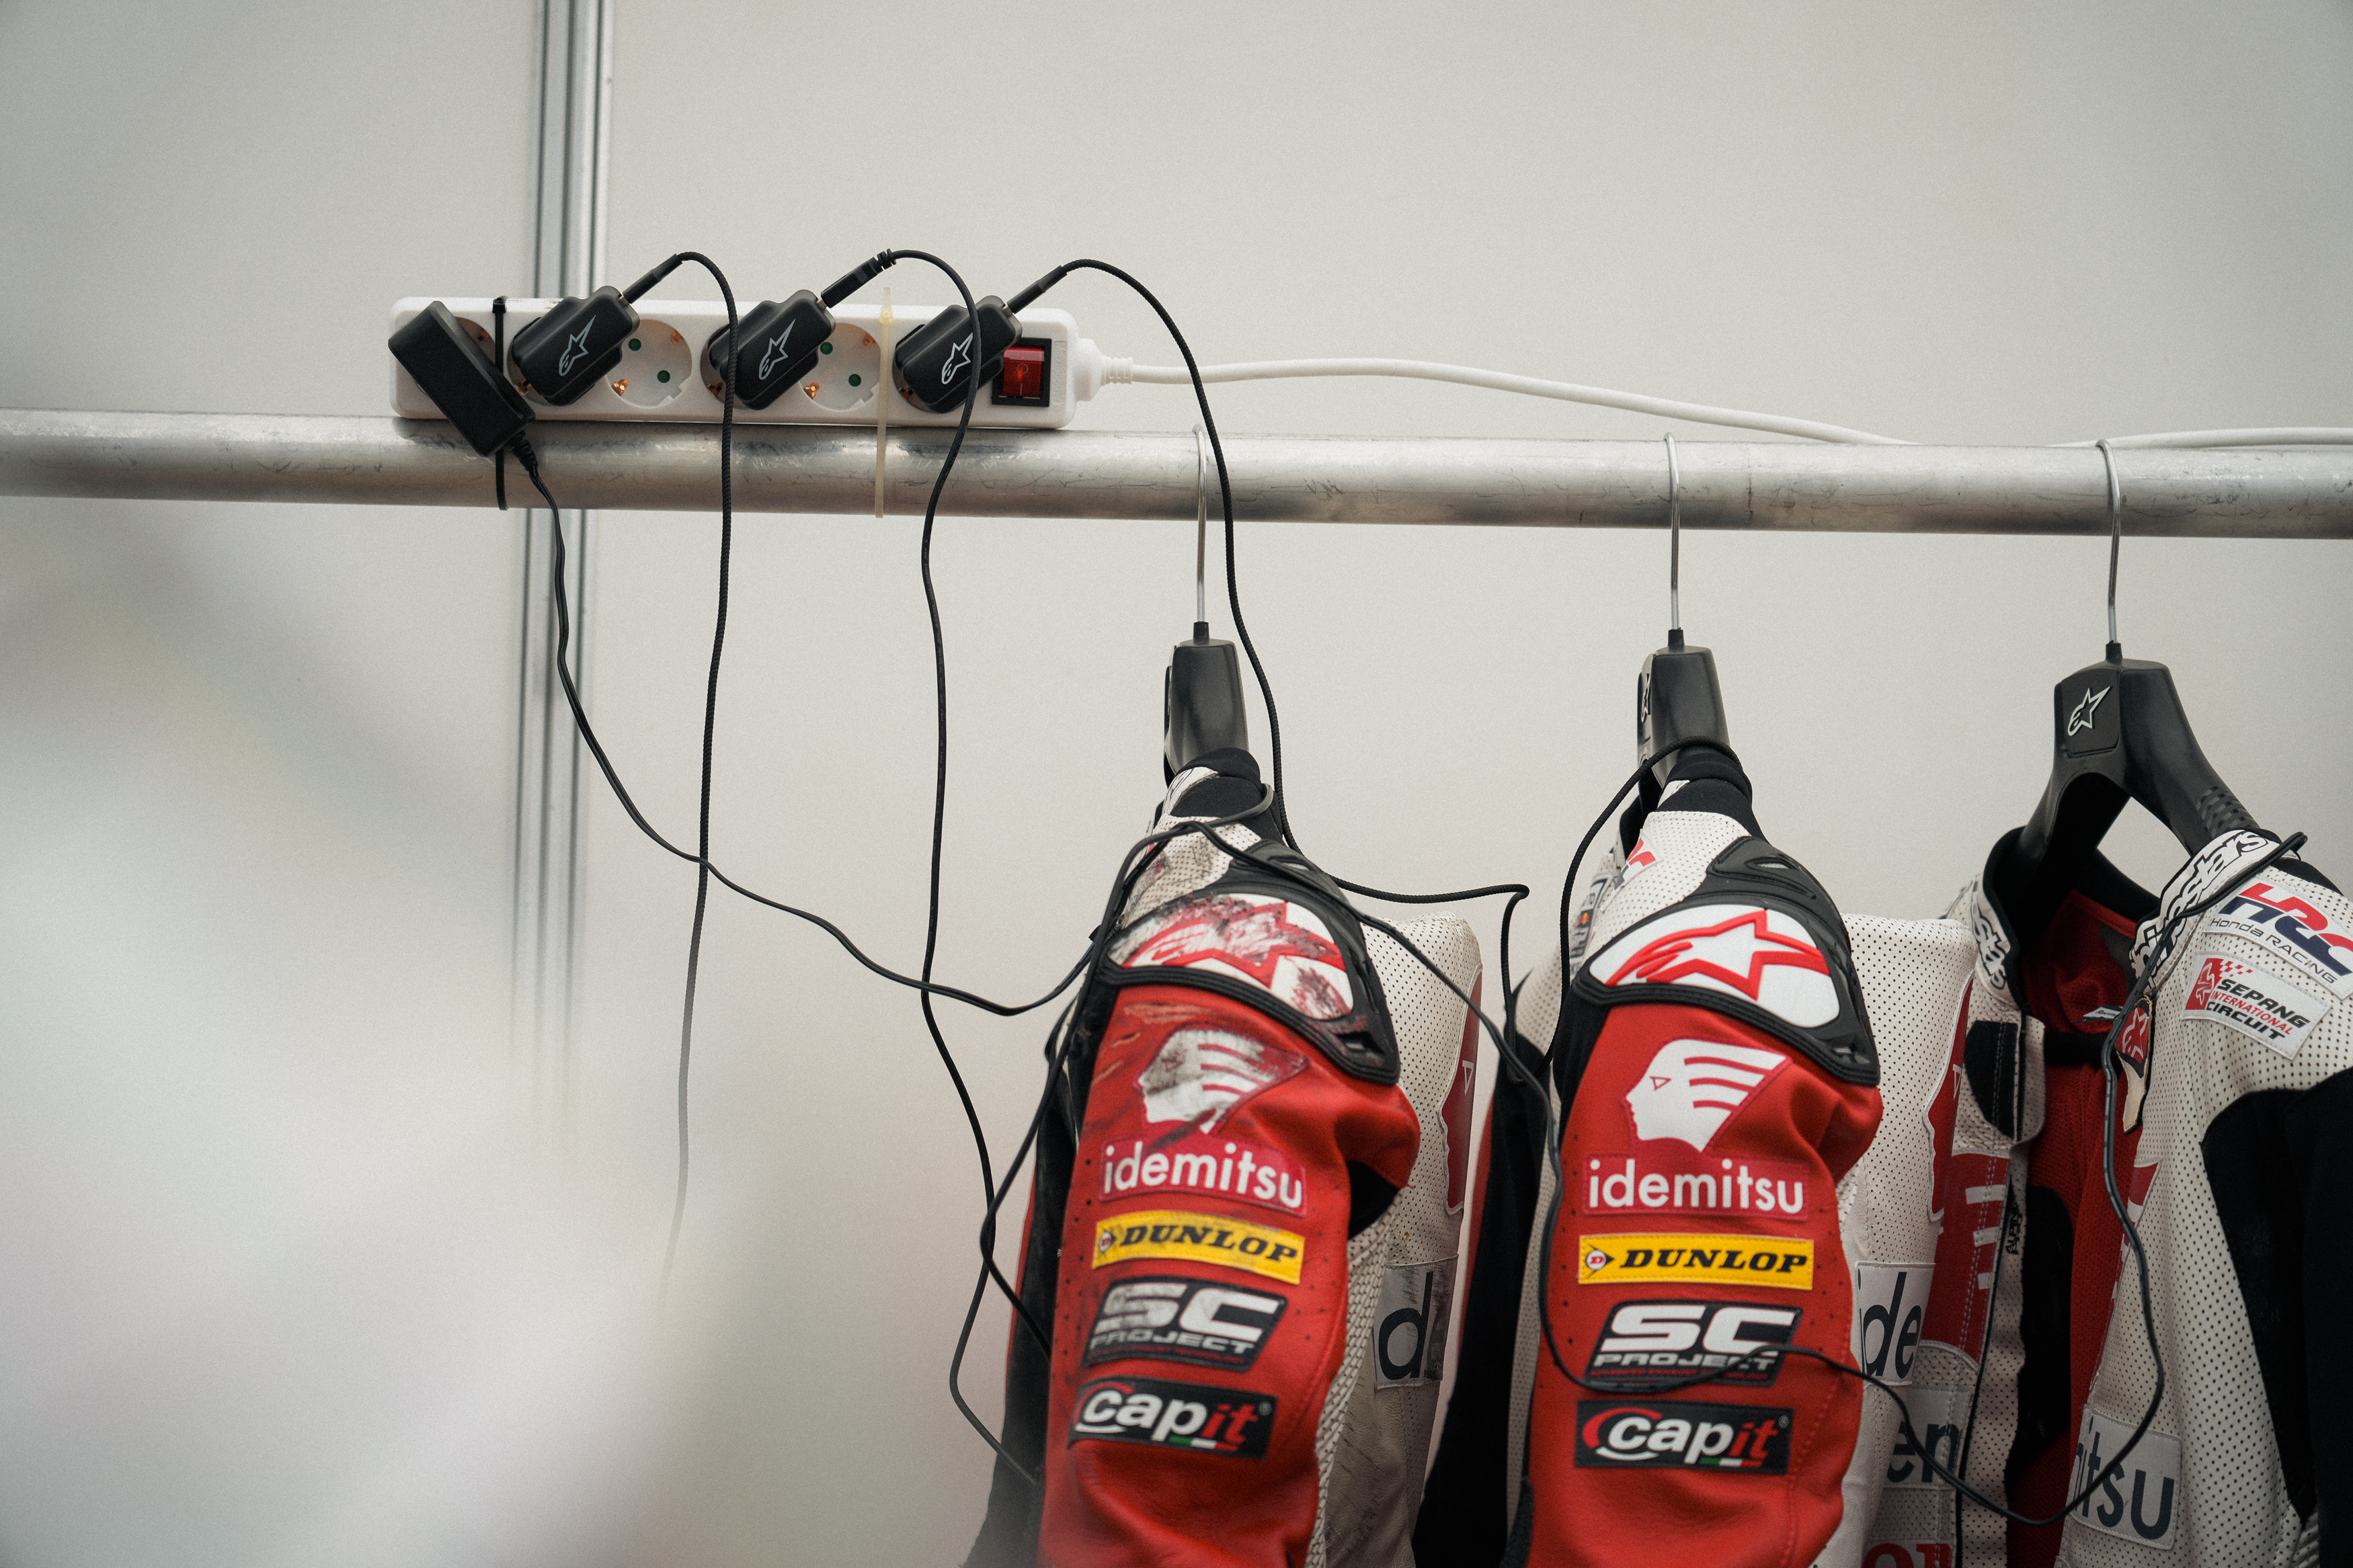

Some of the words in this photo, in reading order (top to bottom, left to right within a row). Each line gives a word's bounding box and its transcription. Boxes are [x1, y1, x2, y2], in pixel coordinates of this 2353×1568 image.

[2210, 918, 2264, 937] Honda
[2266, 935, 2338, 983] RACING
[2206, 1001, 2286, 1039] CIRCUIT
[2211, 991, 2294, 1034] INTERNATIONAL
[2217, 979, 2311, 1028] SEPANG
[1104, 1141, 1303, 1208] idemitsu
[1589, 1158, 1804, 1213] idemitsu
[1120, 1225, 1298, 1262] DUNLOP
[1620, 1249, 1808, 1273] DUNLOP
[1095, 1281, 1282, 1342] SC
[1600, 1304, 1797, 1356] SC
[1089, 1328, 1255, 1355] PROJECT
[2073, 1415, 2175, 1540] itsu
